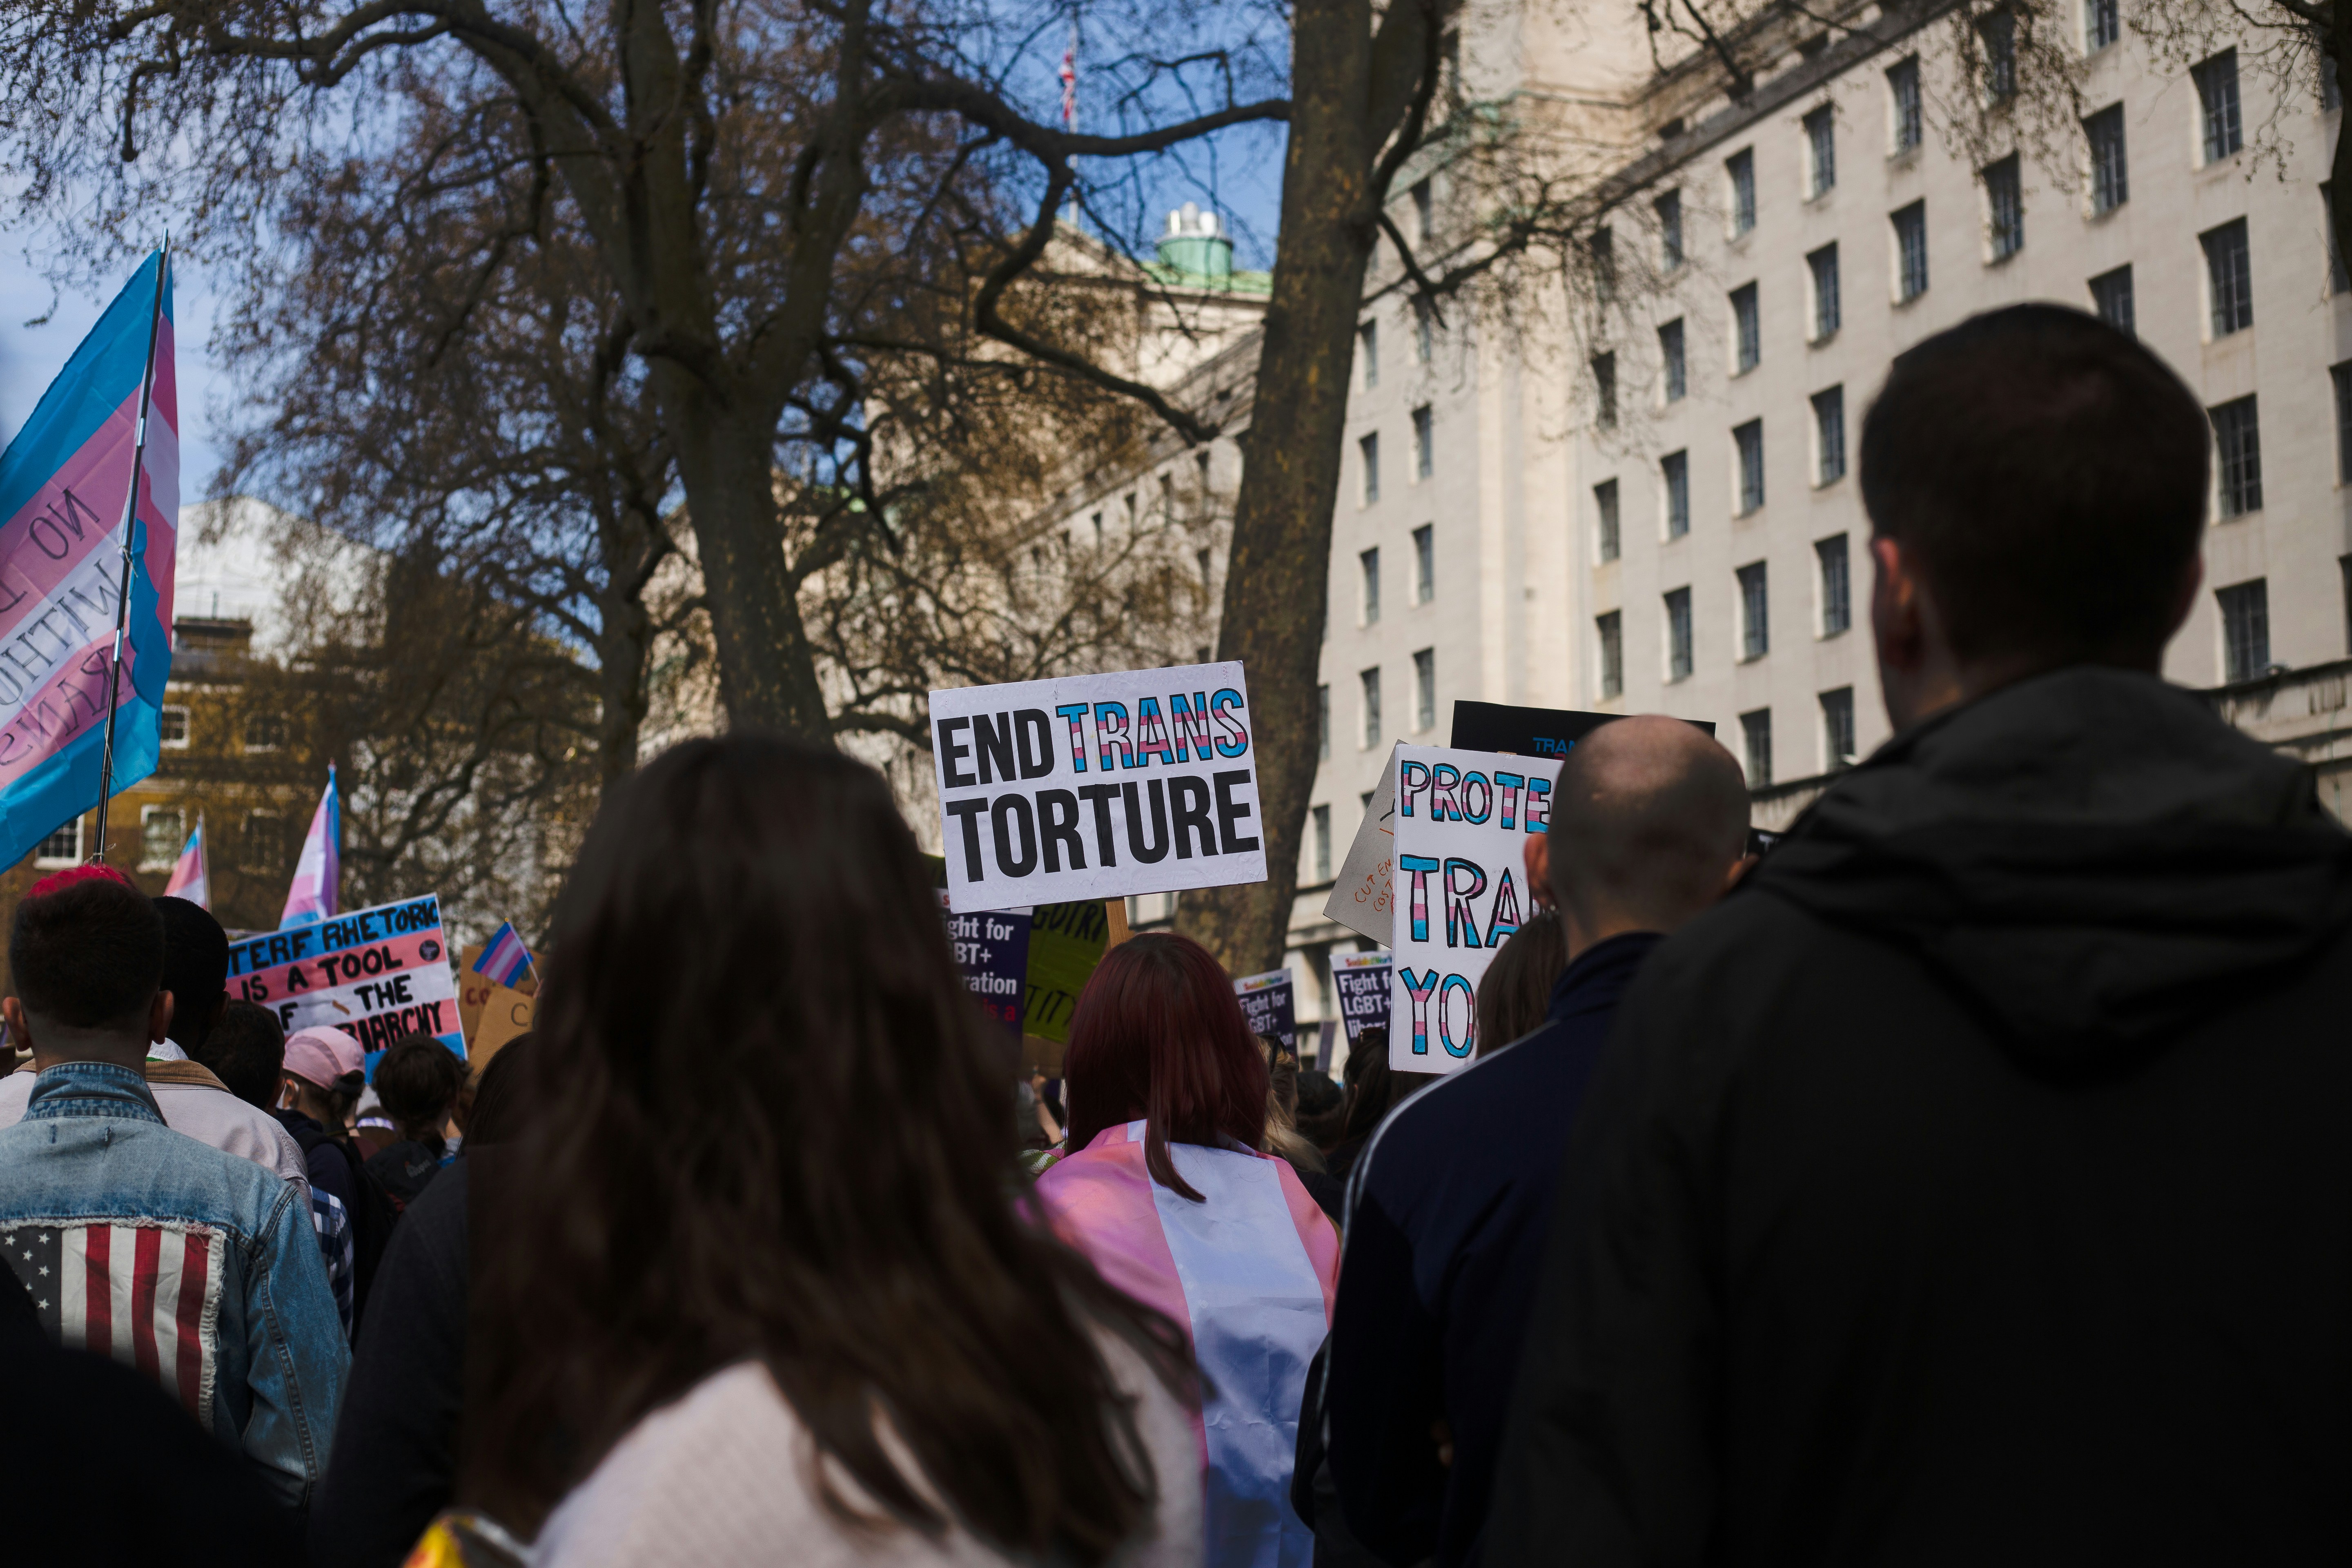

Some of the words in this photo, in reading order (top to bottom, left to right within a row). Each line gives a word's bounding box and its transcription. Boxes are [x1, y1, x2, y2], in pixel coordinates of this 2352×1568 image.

[937, 708, 1055, 789] END
[1056, 688, 1249, 774] TRANS
[946, 769, 1260, 883] TORTURE
[1355, 874, 1375, 903] CUT
[229, 931, 312, 976] TERF
[322, 900, 440, 951] RHETORIC
[985, 918, 1014, 941] for
[241, 975, 268, 1001] IS
[287, 966, 309, 993] A
[317, 946, 403, 987] TOOL
[1339, 973, 1379, 995] Fight
[354, 974, 413, 1011] THE
[1343, 994, 1391, 1016] LGBT+
[1004, 1004, 1016, 1022] a
[1398, 967, 1475, 1059] YO
